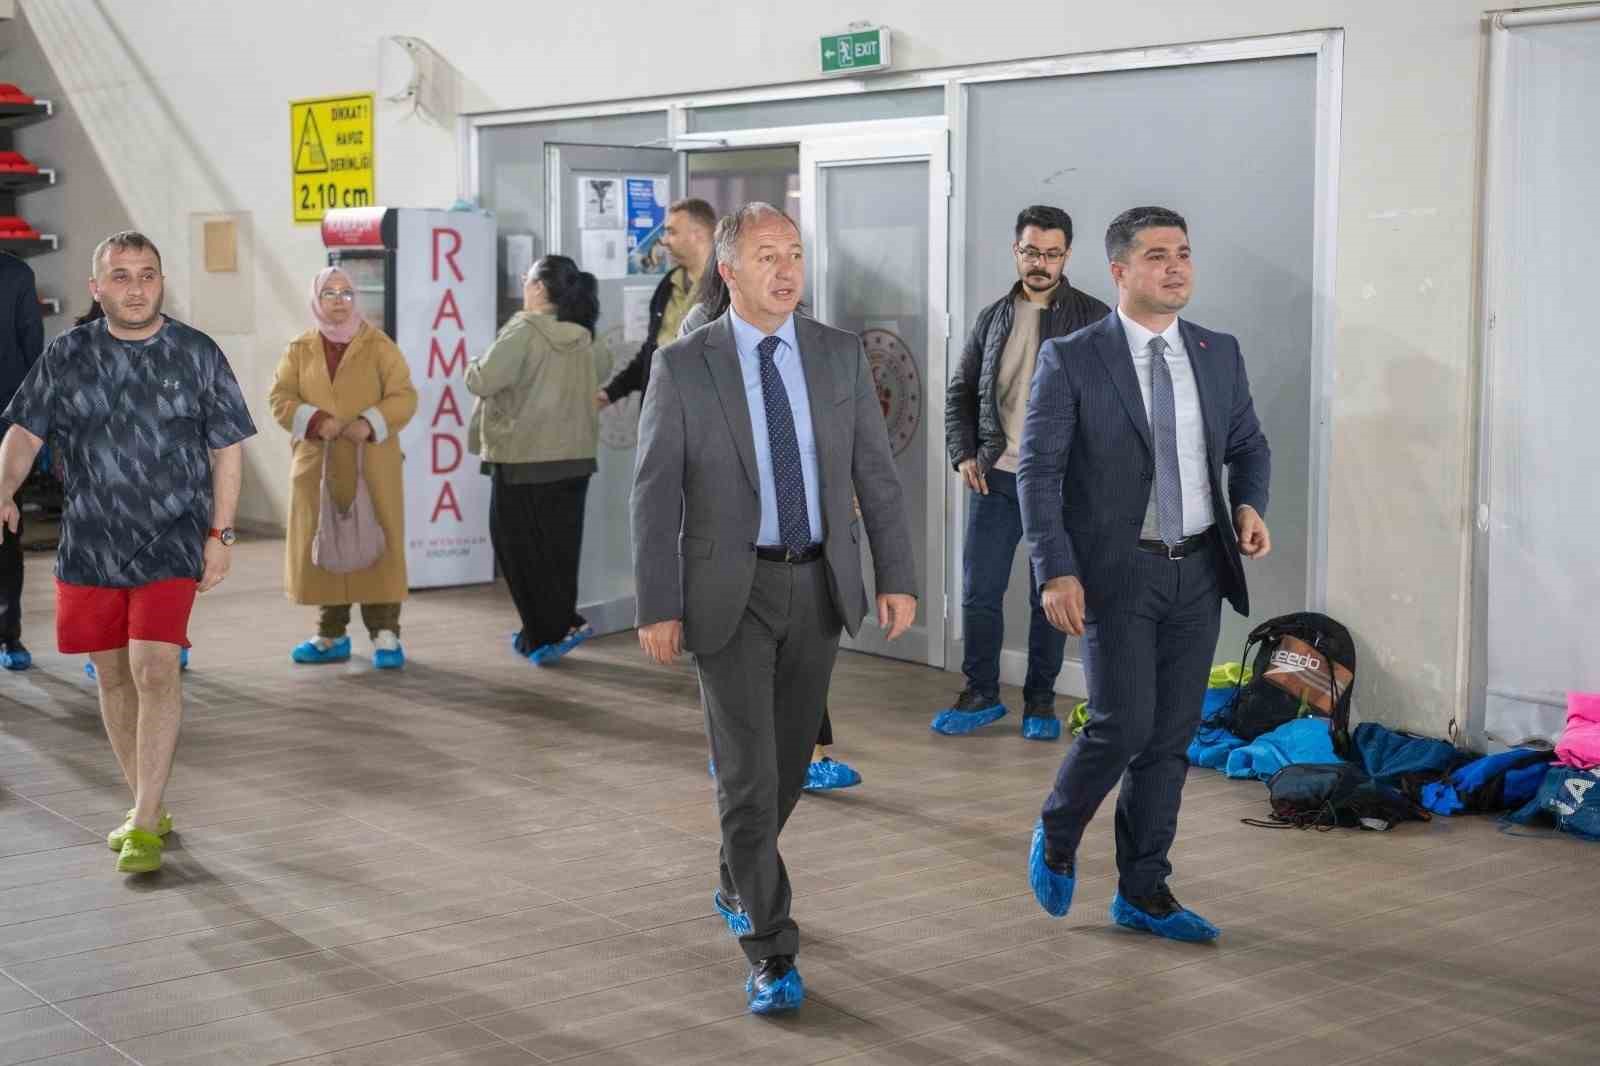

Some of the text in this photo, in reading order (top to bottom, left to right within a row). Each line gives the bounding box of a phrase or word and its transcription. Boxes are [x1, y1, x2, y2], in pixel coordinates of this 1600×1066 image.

[855, 40, 877, 57] EXIT
[301, 183, 369, 209] 2.10 cm
[427, 227, 468, 524] RAMADA
